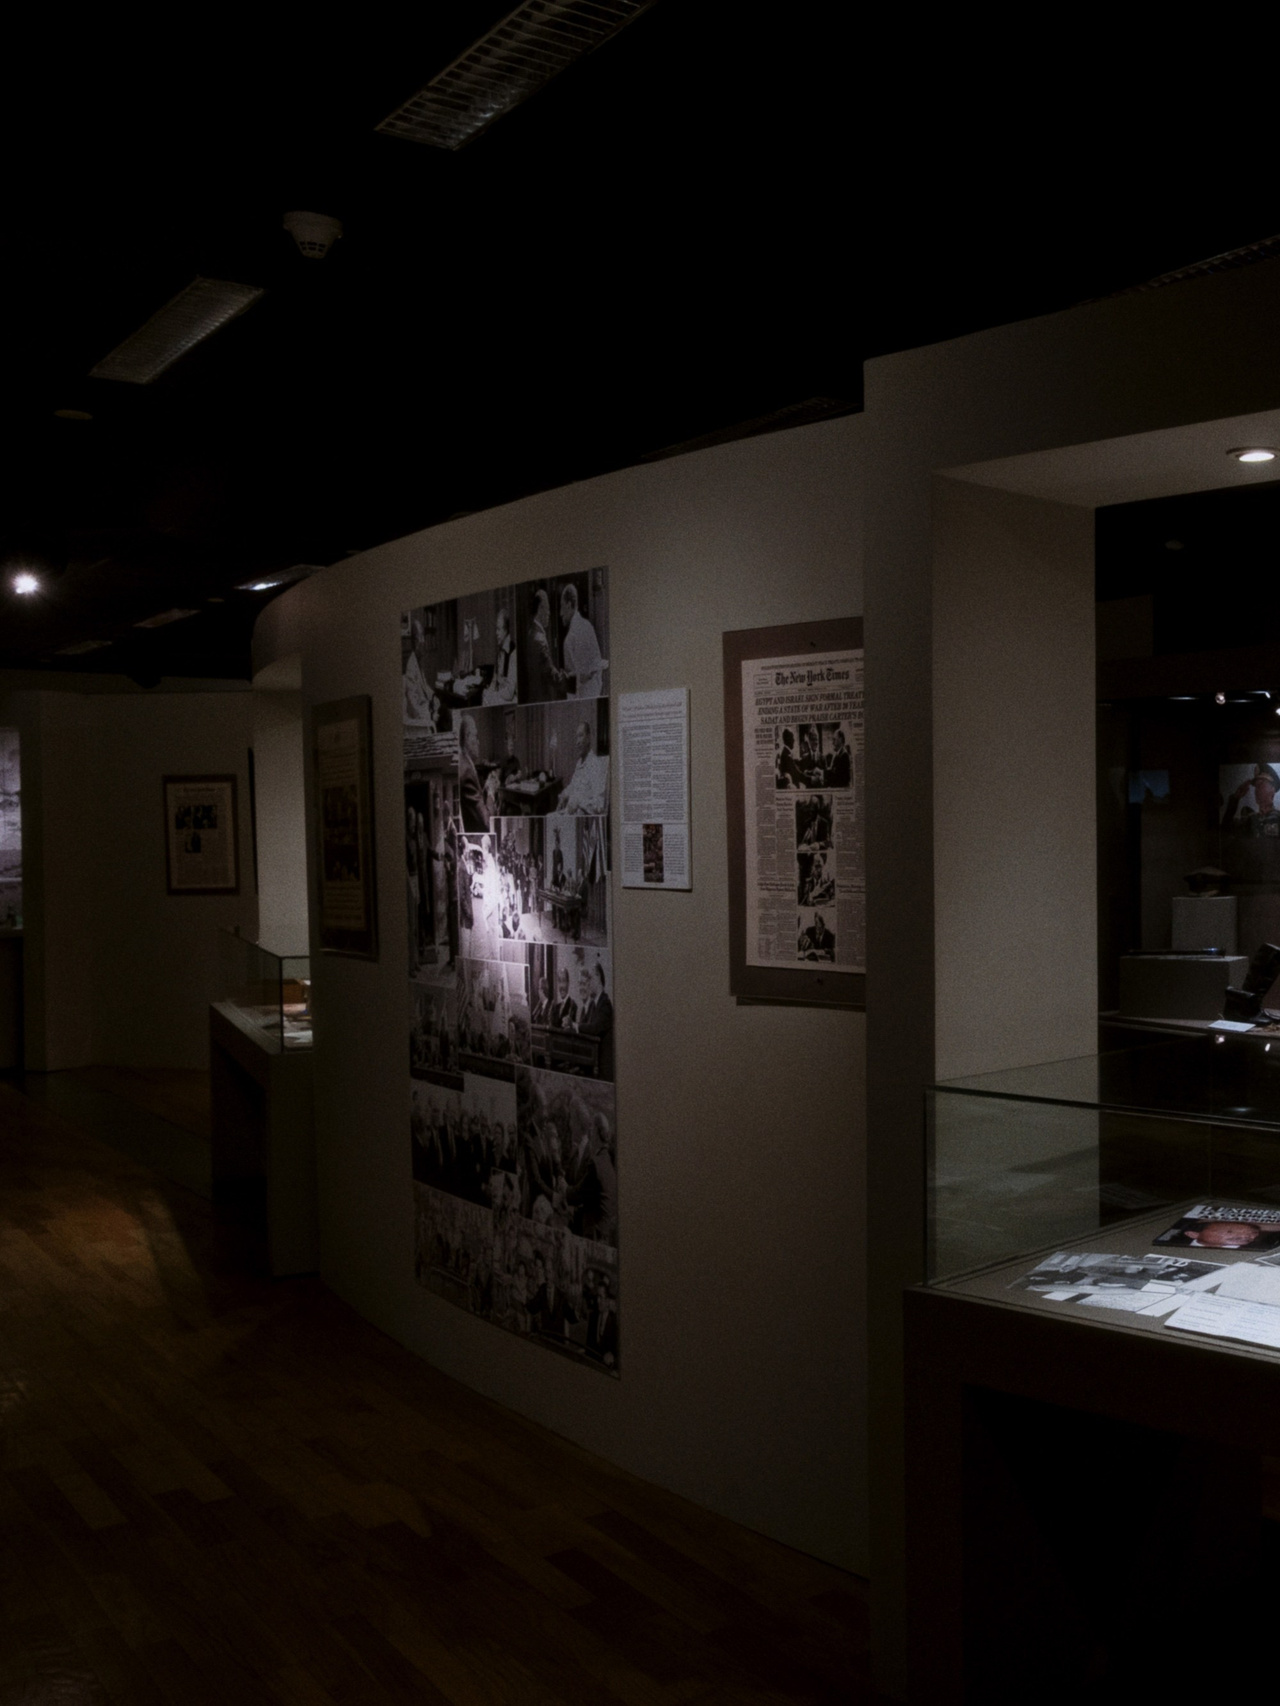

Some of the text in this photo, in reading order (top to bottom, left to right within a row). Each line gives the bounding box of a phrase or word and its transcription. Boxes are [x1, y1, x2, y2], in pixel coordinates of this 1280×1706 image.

[775, 672, 790, 686] The
[790, 670, 806, 685] New
[806, 669, 825, 687] York
[826, 668, 850, 682] Times
[773, 696, 785, 705] AND
